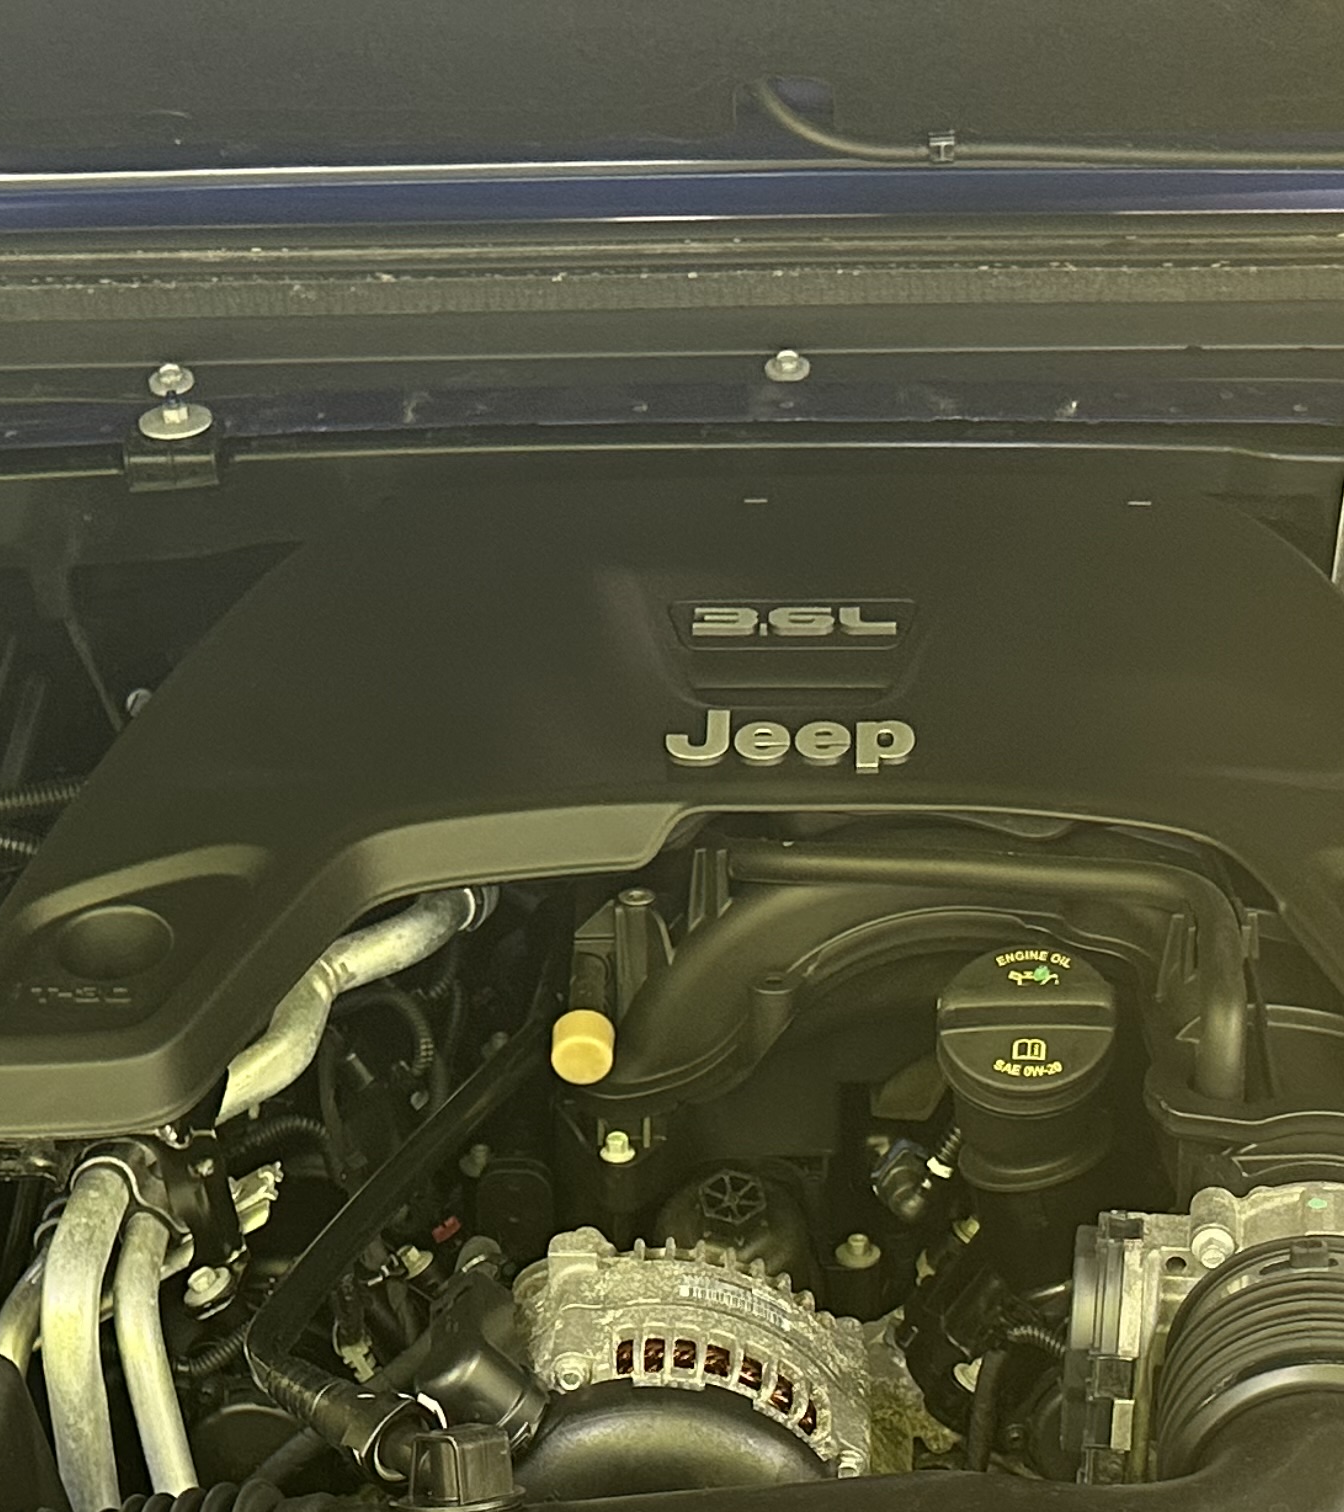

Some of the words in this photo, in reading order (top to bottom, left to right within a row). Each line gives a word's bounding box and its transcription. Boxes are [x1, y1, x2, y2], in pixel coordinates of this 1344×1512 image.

[692, 606, 898, 637] 3.6L
[664, 708, 917, 775] Jeep
[995, 949, 1048, 967] ENGINE
[1050, 951, 1073, 969] OIL
[993, 1058, 1022, 1076] SAE
[1023, 1060, 1063, 1077] 0W-20
